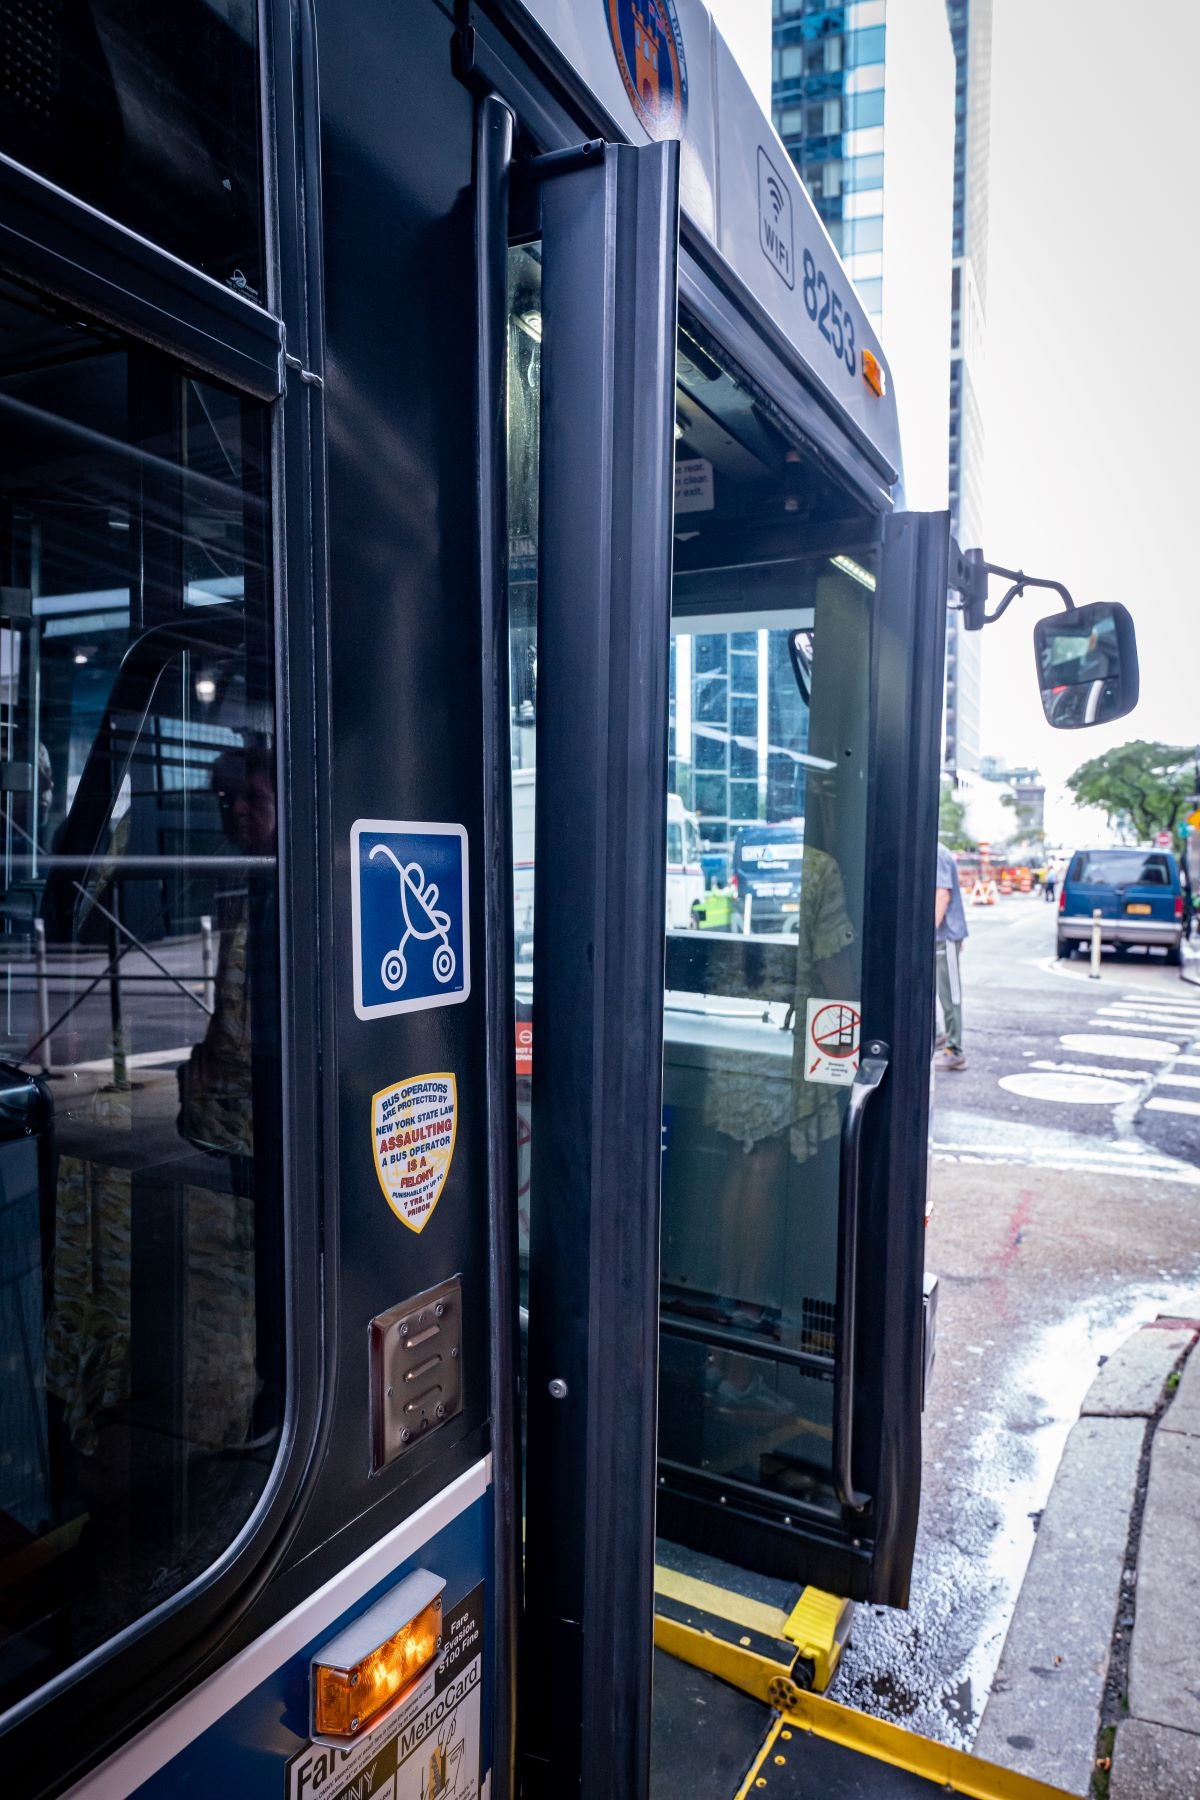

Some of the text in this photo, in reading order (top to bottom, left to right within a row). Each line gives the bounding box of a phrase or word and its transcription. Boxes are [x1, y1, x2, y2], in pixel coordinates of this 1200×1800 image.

[764, 218, 789, 274] WIFI
[803, 248, 856, 377] 8253
[382, 1083, 448, 1112] BUS OPERATORS
[382, 1095, 447, 1122] ARE PROTECTED BY
[376, 1104, 454, 1136] NEW YORK STATE LAW
[380, 1118, 452, 1154] ASSAULTING
[382, 1136, 450, 1167] A BUS OPERATOR
[407, 1156, 427, 1173] IS A
[392, 1173, 444, 1198] PUNISHABLE BY UP TO
[400, 1166, 434, 1188] FELONY
[408, 1202, 430, 1217] PRISON
[426, 1192, 434, 1200] IN
[444, 1619, 475, 1653] Evasion
[450, 1612, 469, 1635] Fare
[440, 1630, 479, 1674] $100 Fine
[401, 1661, 477, 1757] MetroCard
